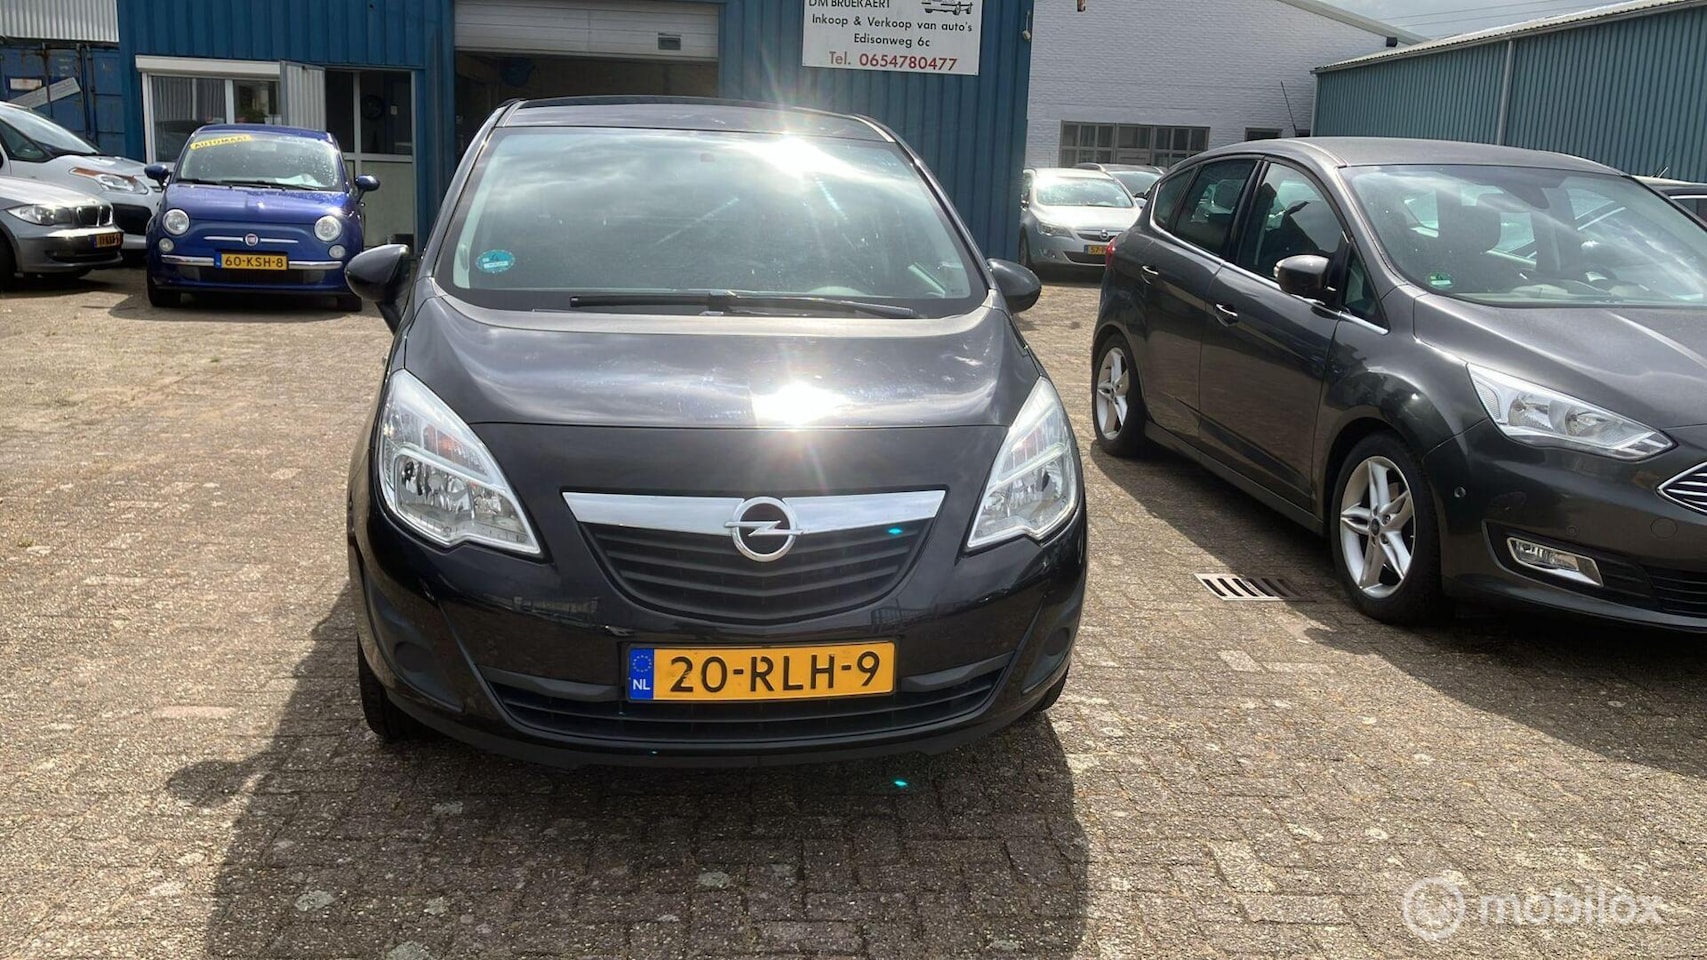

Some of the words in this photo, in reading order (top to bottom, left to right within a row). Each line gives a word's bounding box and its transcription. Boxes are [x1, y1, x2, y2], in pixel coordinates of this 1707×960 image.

[812, 14, 848, 27] Inkoop
[853, 16, 861, 26] &
[867, 16, 912, 30] Verkoop
[917, 22, 937, 30] van
[941, 22, 972, 32] auto's
[854, 33, 912, 48] Edisonweg
[917, 37, 930, 47] 6c
[829, 51, 851, 65] Tel.
[859, 53, 957, 71] 0654780477
[225, 256, 284, 268] 60-KSH-8
[633, 678, 650, 690] NL
[670, 651, 880, 692] 20-RLH-9
